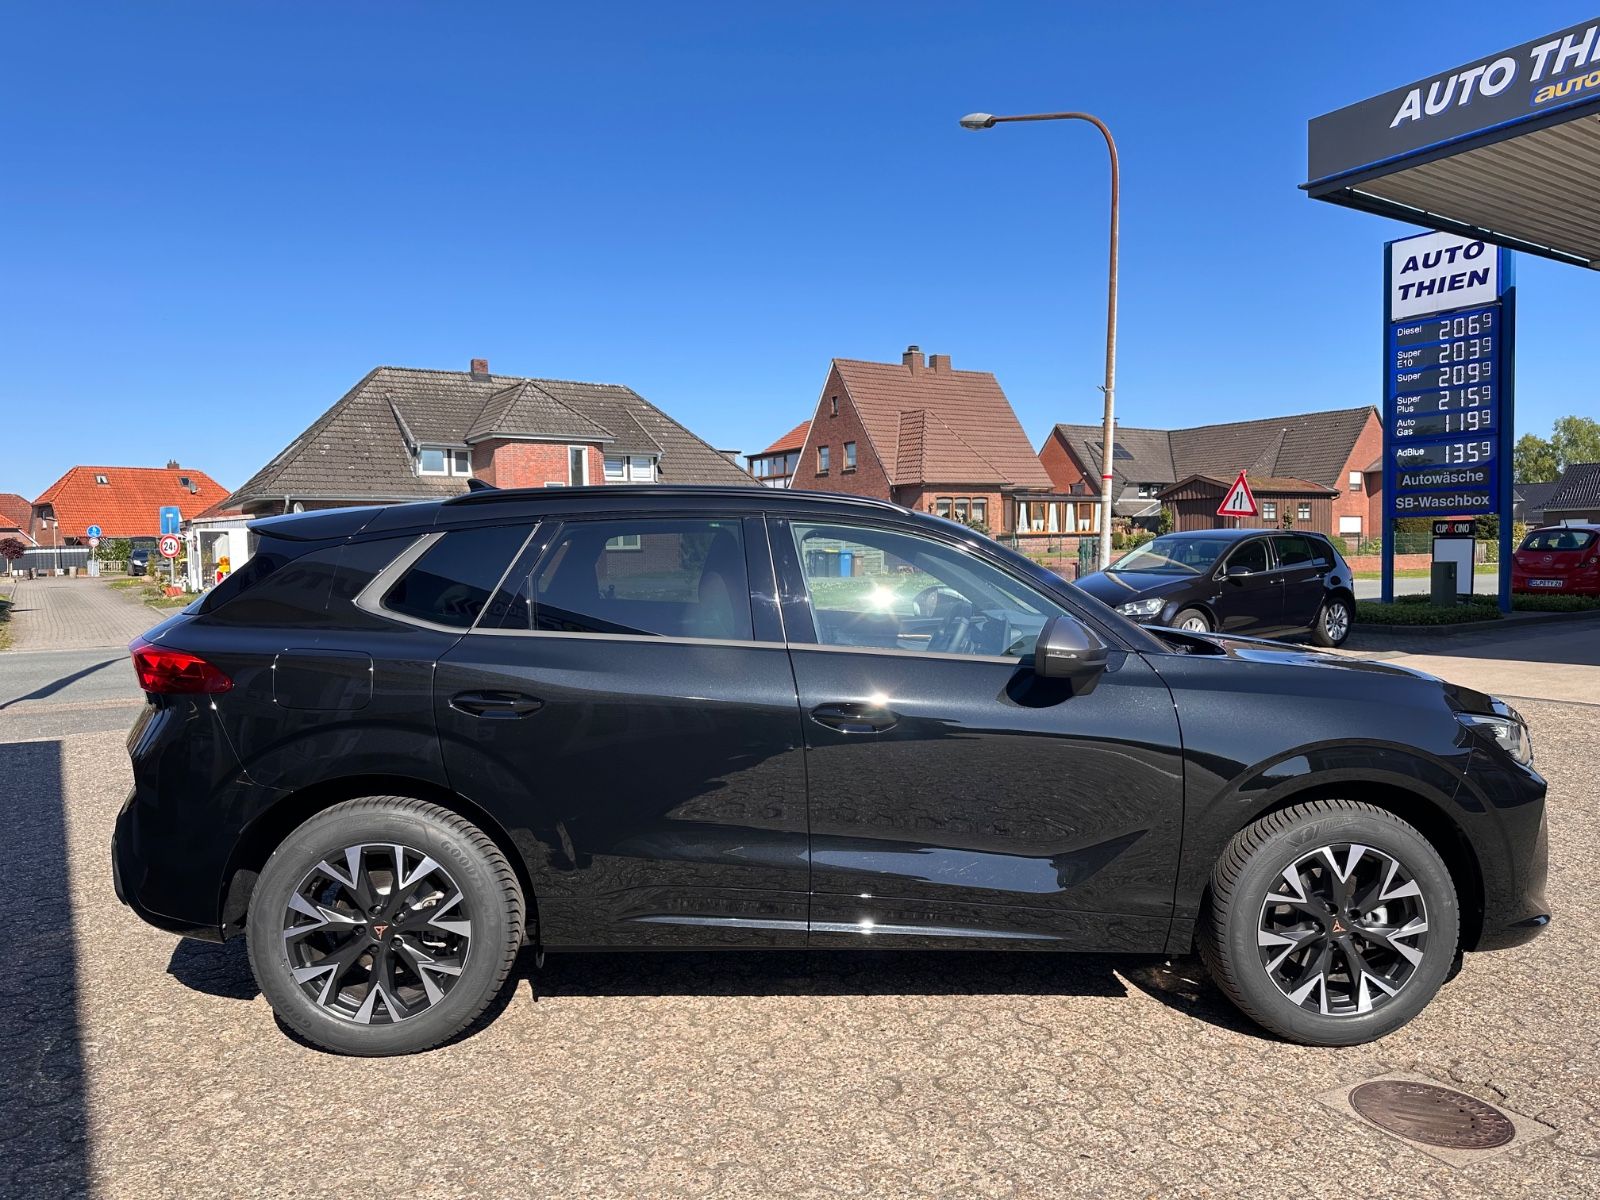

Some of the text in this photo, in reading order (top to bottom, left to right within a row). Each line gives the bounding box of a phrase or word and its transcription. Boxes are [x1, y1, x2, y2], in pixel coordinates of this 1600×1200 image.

[1389, 57, 1519, 128] AUTO
[1400, 240, 1485, 275] AUTO
[1398, 267, 1490, 301] THIEN
[1397, 325, 1422, 337] Diesel
[1397, 349, 1422, 360] Super
[1397, 359, 1413, 369] E10
[1397, 372, 1422, 383] Super
[1397, 395, 1422, 406] Super
[1396, 405, 1414, 415] Plus
[1396, 418, 1416, 428] Auto
[1396, 428, 1413, 437] Gas
[1396, 448, 1425, 458] AdBlue
[1401, 470, 1484, 487] Autowäsche
[1395, 494, 1490, 510] SB-Waschbox
